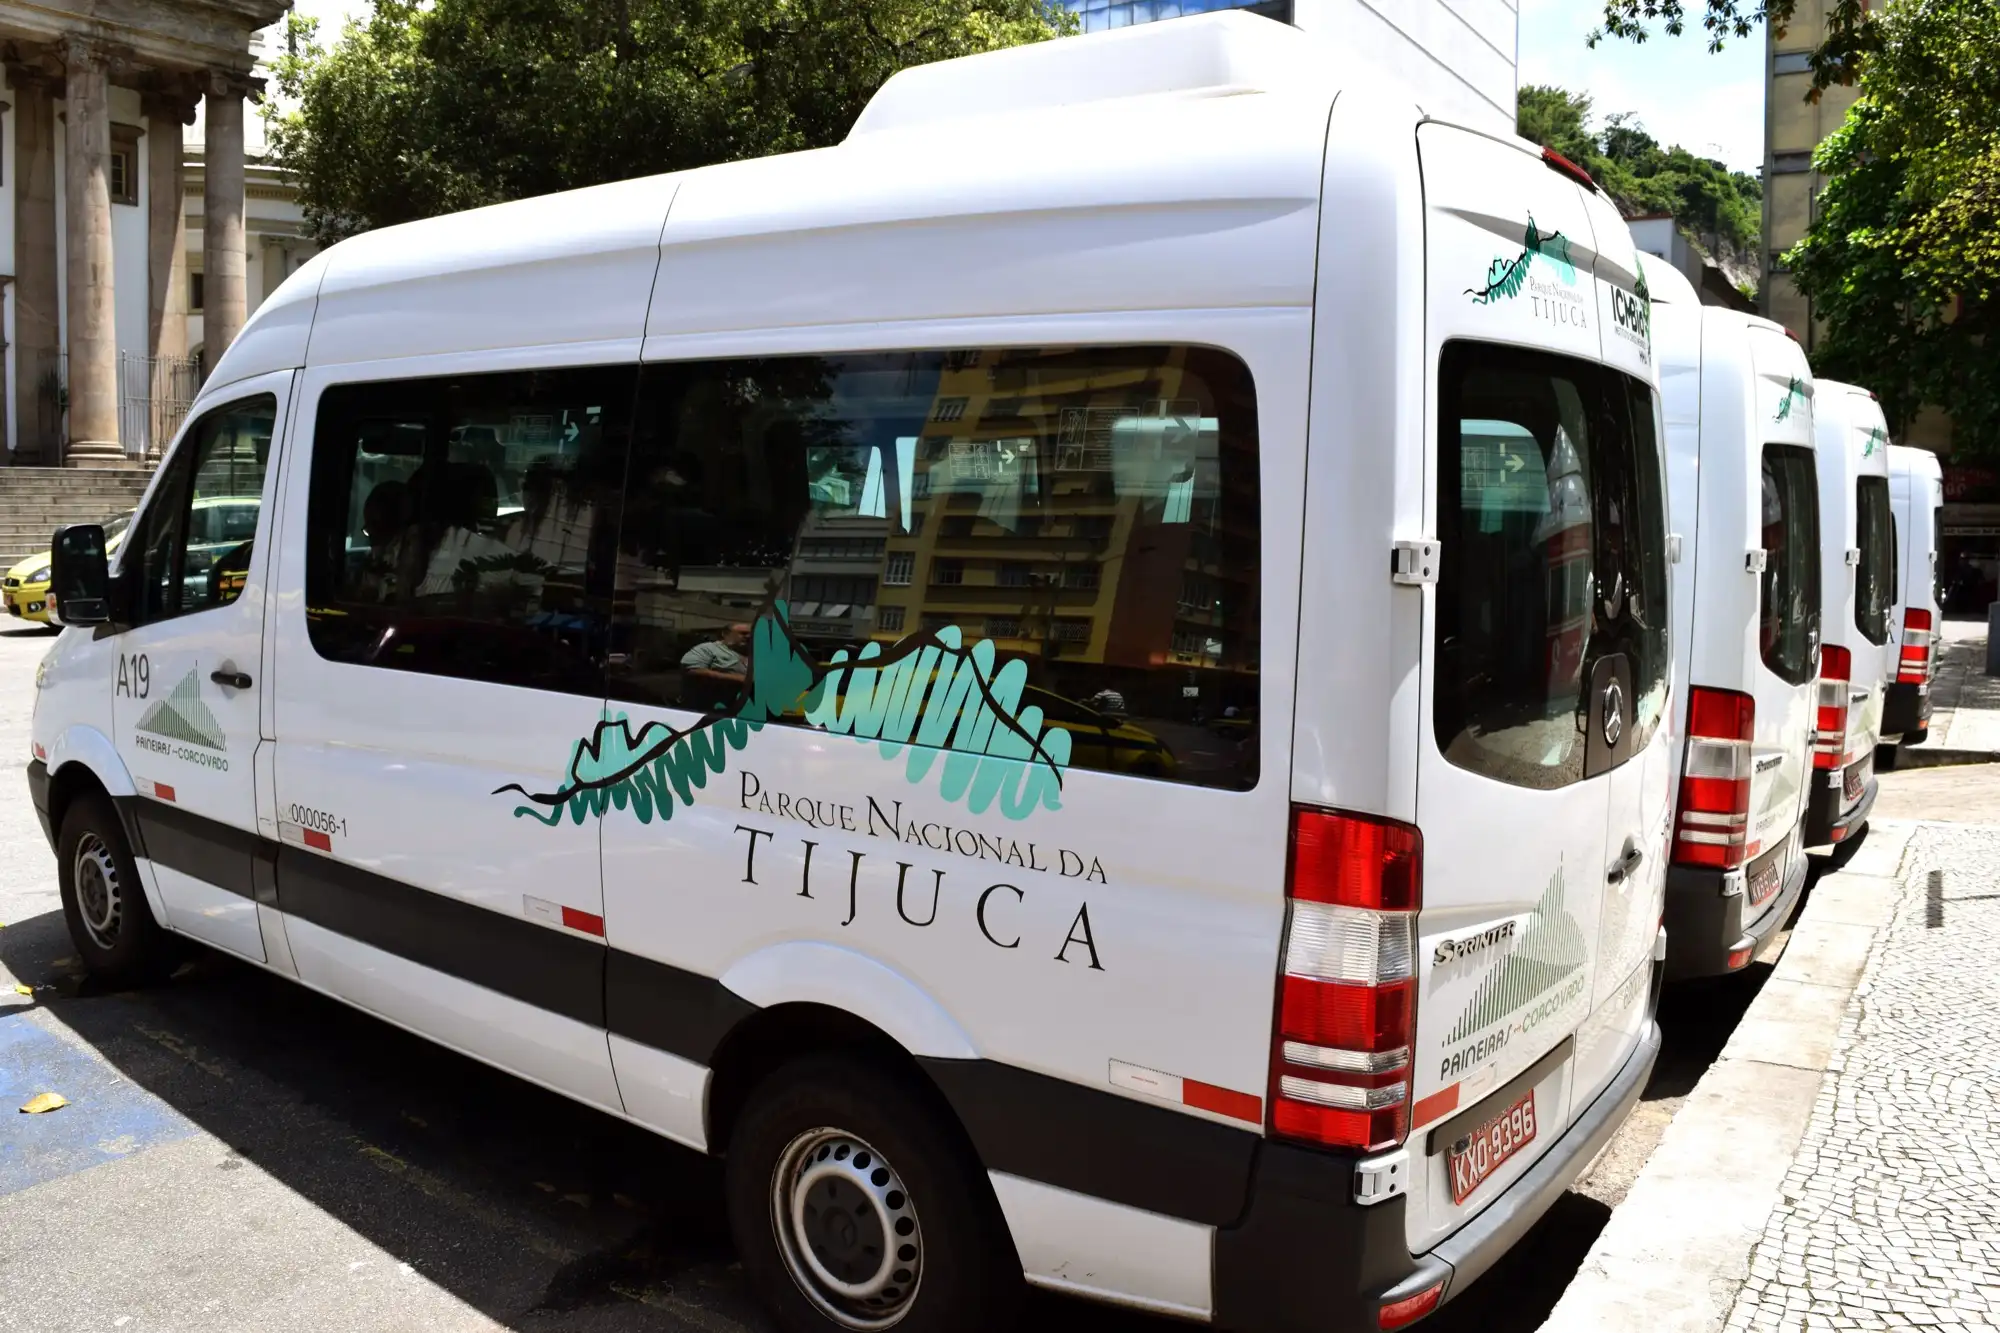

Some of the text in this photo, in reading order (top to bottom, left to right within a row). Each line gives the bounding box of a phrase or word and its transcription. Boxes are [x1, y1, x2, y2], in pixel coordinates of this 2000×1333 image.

[1531, 295, 1587, 328] TIJUCA
[116, 653, 150, 699] A19
[135, 735, 229, 772] PAINEIRAS CORCOVADO
[291, 803, 348, 838] 000056-1
[1058, 848, 1108, 885] DA
[733, 823, 1106, 972] TIJUCA
[1432, 921, 1517, 967] SPRINTER
[1440, 1023, 1513, 1081] PAINEIRAS
[1522, 974, 1586, 1034] CORCOVADO
